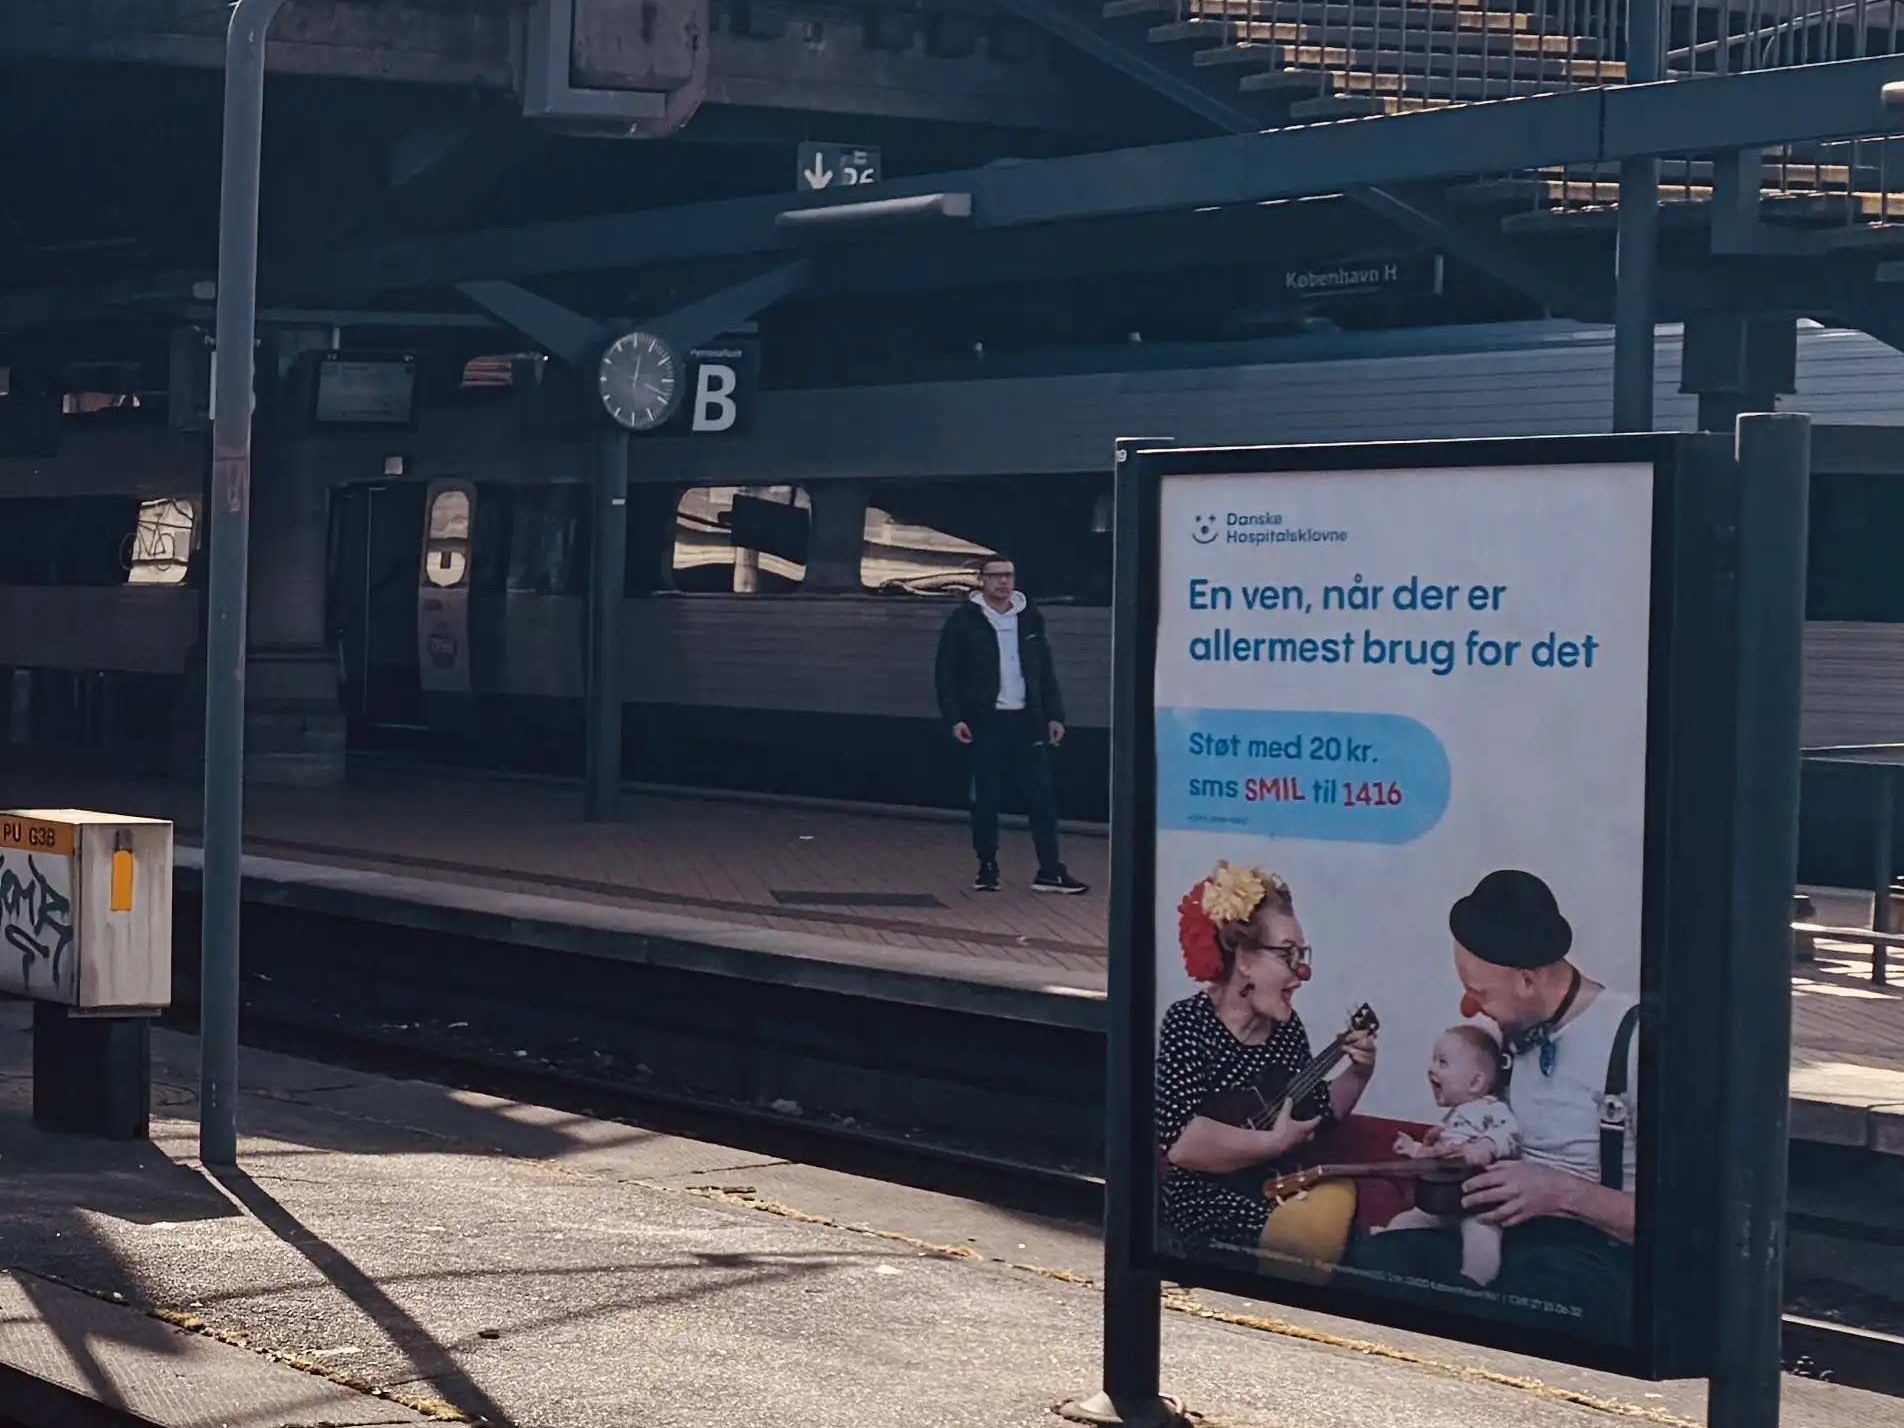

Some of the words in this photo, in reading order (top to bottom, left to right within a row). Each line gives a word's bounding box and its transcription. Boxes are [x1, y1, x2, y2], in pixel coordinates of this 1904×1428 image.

[1384, 262, 1397, 281] H
[692, 364, 737, 432] B
[1226, 512, 1282, 527] Danske
[1226, 528, 1348, 546] Hospitalsklovne
[1189, 578, 1232, 610] En
[1242, 586, 1312, 614] ven,
[1322, 574, 1383, 611] når
[1392, 576, 1460, 611] der
[1467, 584, 1507, 611] er
[1189, 628, 1355, 664] allermest
[1363, 629, 1455, 676] brug
[1465, 630, 1522, 668] for
[1531, 632, 1599, 669] det
[1189, 732, 1241, 756] Støt
[1248, 735, 1302, 759] med
[1309, 736, 1341, 762] 20
[1347, 737, 1379, 763] kr.
[1189, 779, 1239, 798] sms
[1245, 777, 1306, 802] SMIL
[1312, 779, 1337, 804] til
[1342, 781, 1403, 807] 1416
[4, 823, 21, 842] PU
